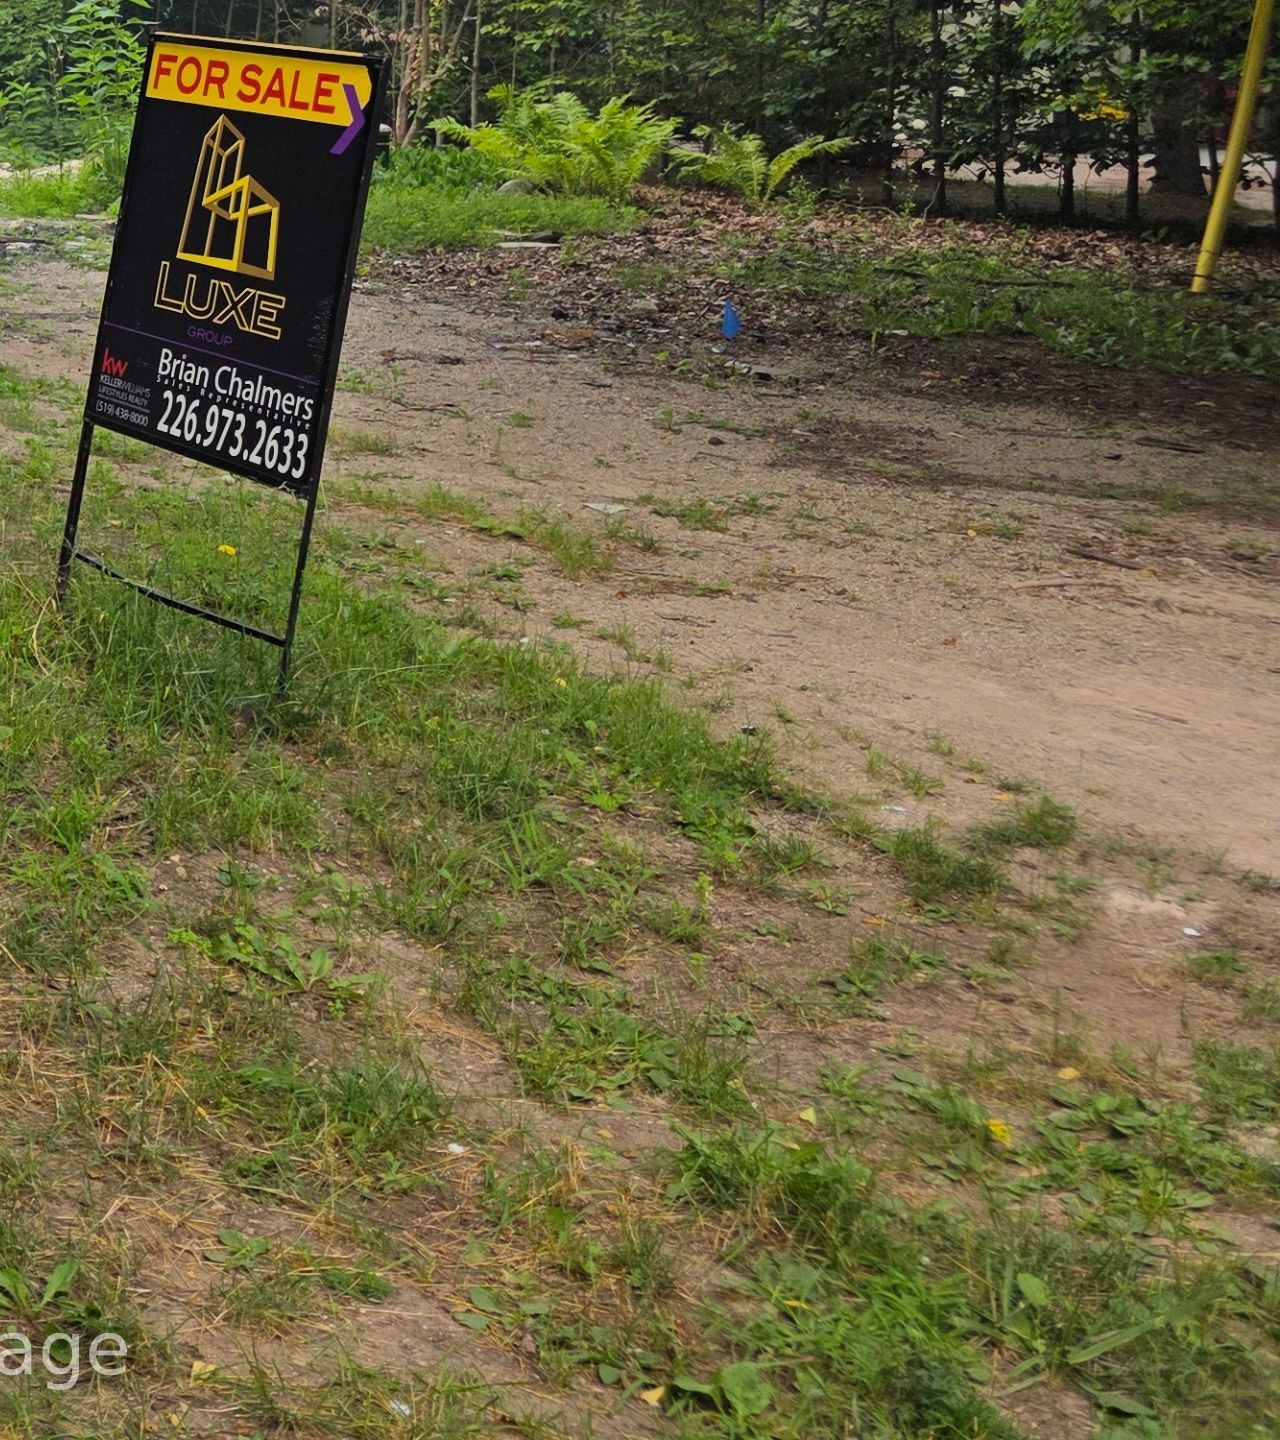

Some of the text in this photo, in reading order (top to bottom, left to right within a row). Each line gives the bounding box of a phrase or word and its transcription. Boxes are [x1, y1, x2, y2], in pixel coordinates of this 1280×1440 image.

[153, 54, 340, 114] FOR SALE
[153, 260, 286, 340] LUXE
[101, 347, 129, 377] kw
[187, 325, 233, 348] GROUP
[156, 375, 311, 430] Sales Representative
[157, 348, 314, 421] Brian Chalmers
[96, 400, 115, 416] (519)
[114, 406, 149, 427] 438-8000
[156, 390, 309, 479] 226.973.2633
